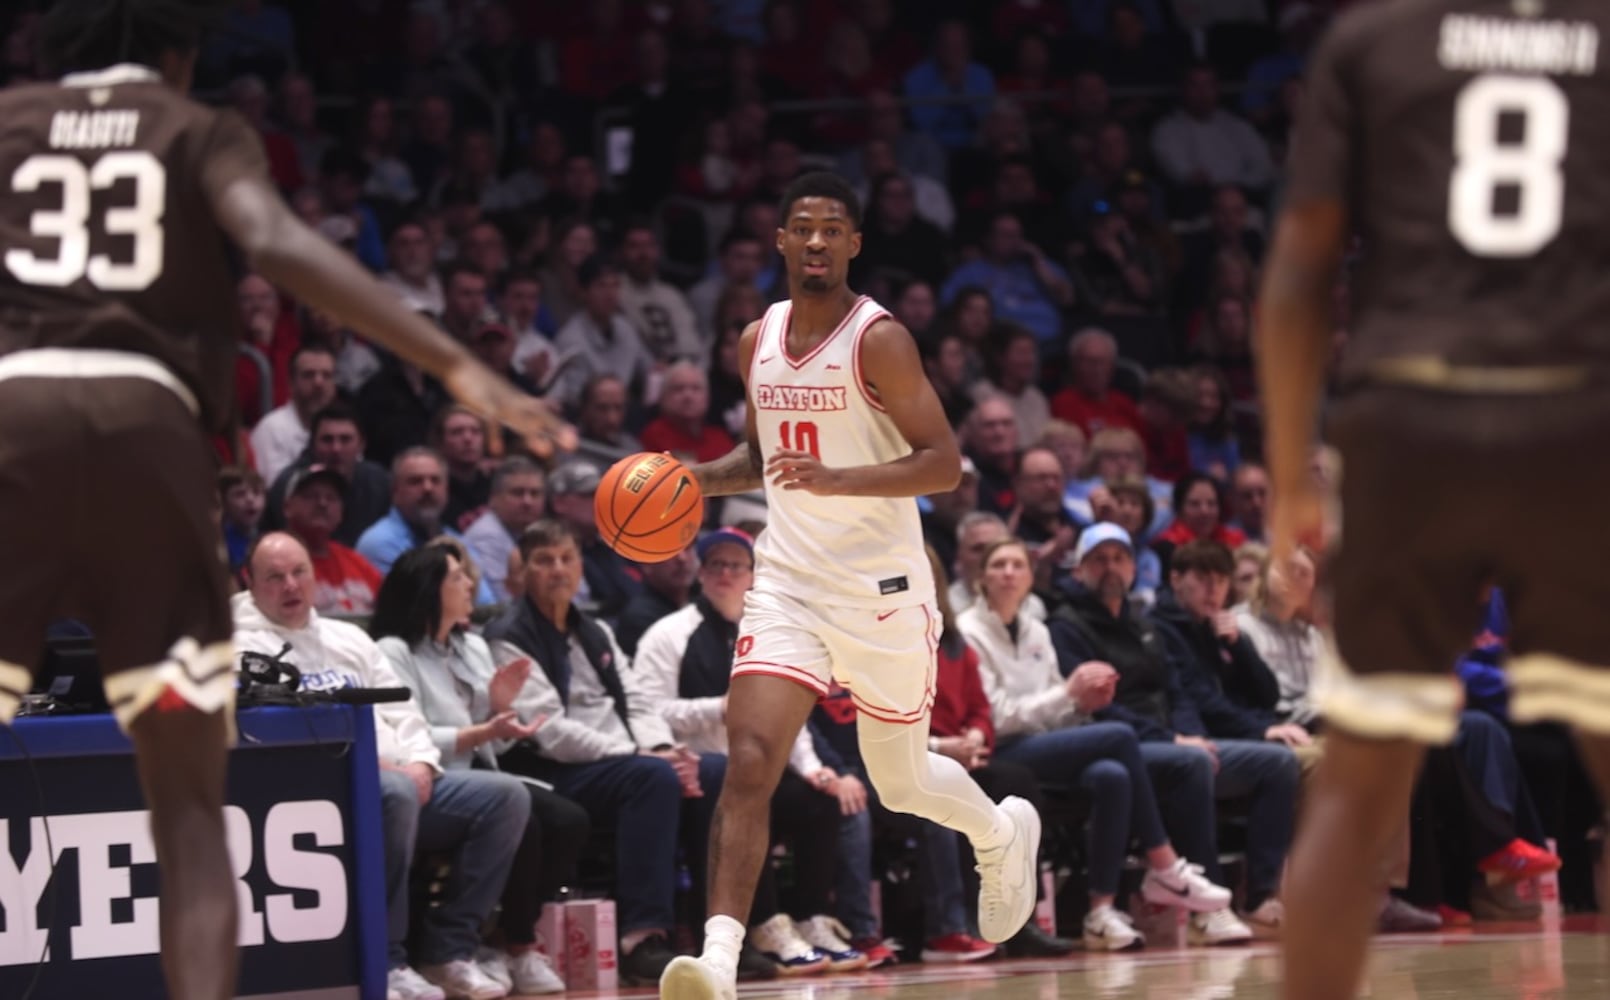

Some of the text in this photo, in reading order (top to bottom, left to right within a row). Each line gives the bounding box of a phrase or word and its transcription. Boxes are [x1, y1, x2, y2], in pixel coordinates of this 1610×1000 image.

[1448, 76, 1568, 257] 8
[5, 152, 166, 291] 33
[758, 385, 847, 411] DAYTON
[780, 421, 821, 461] 10
